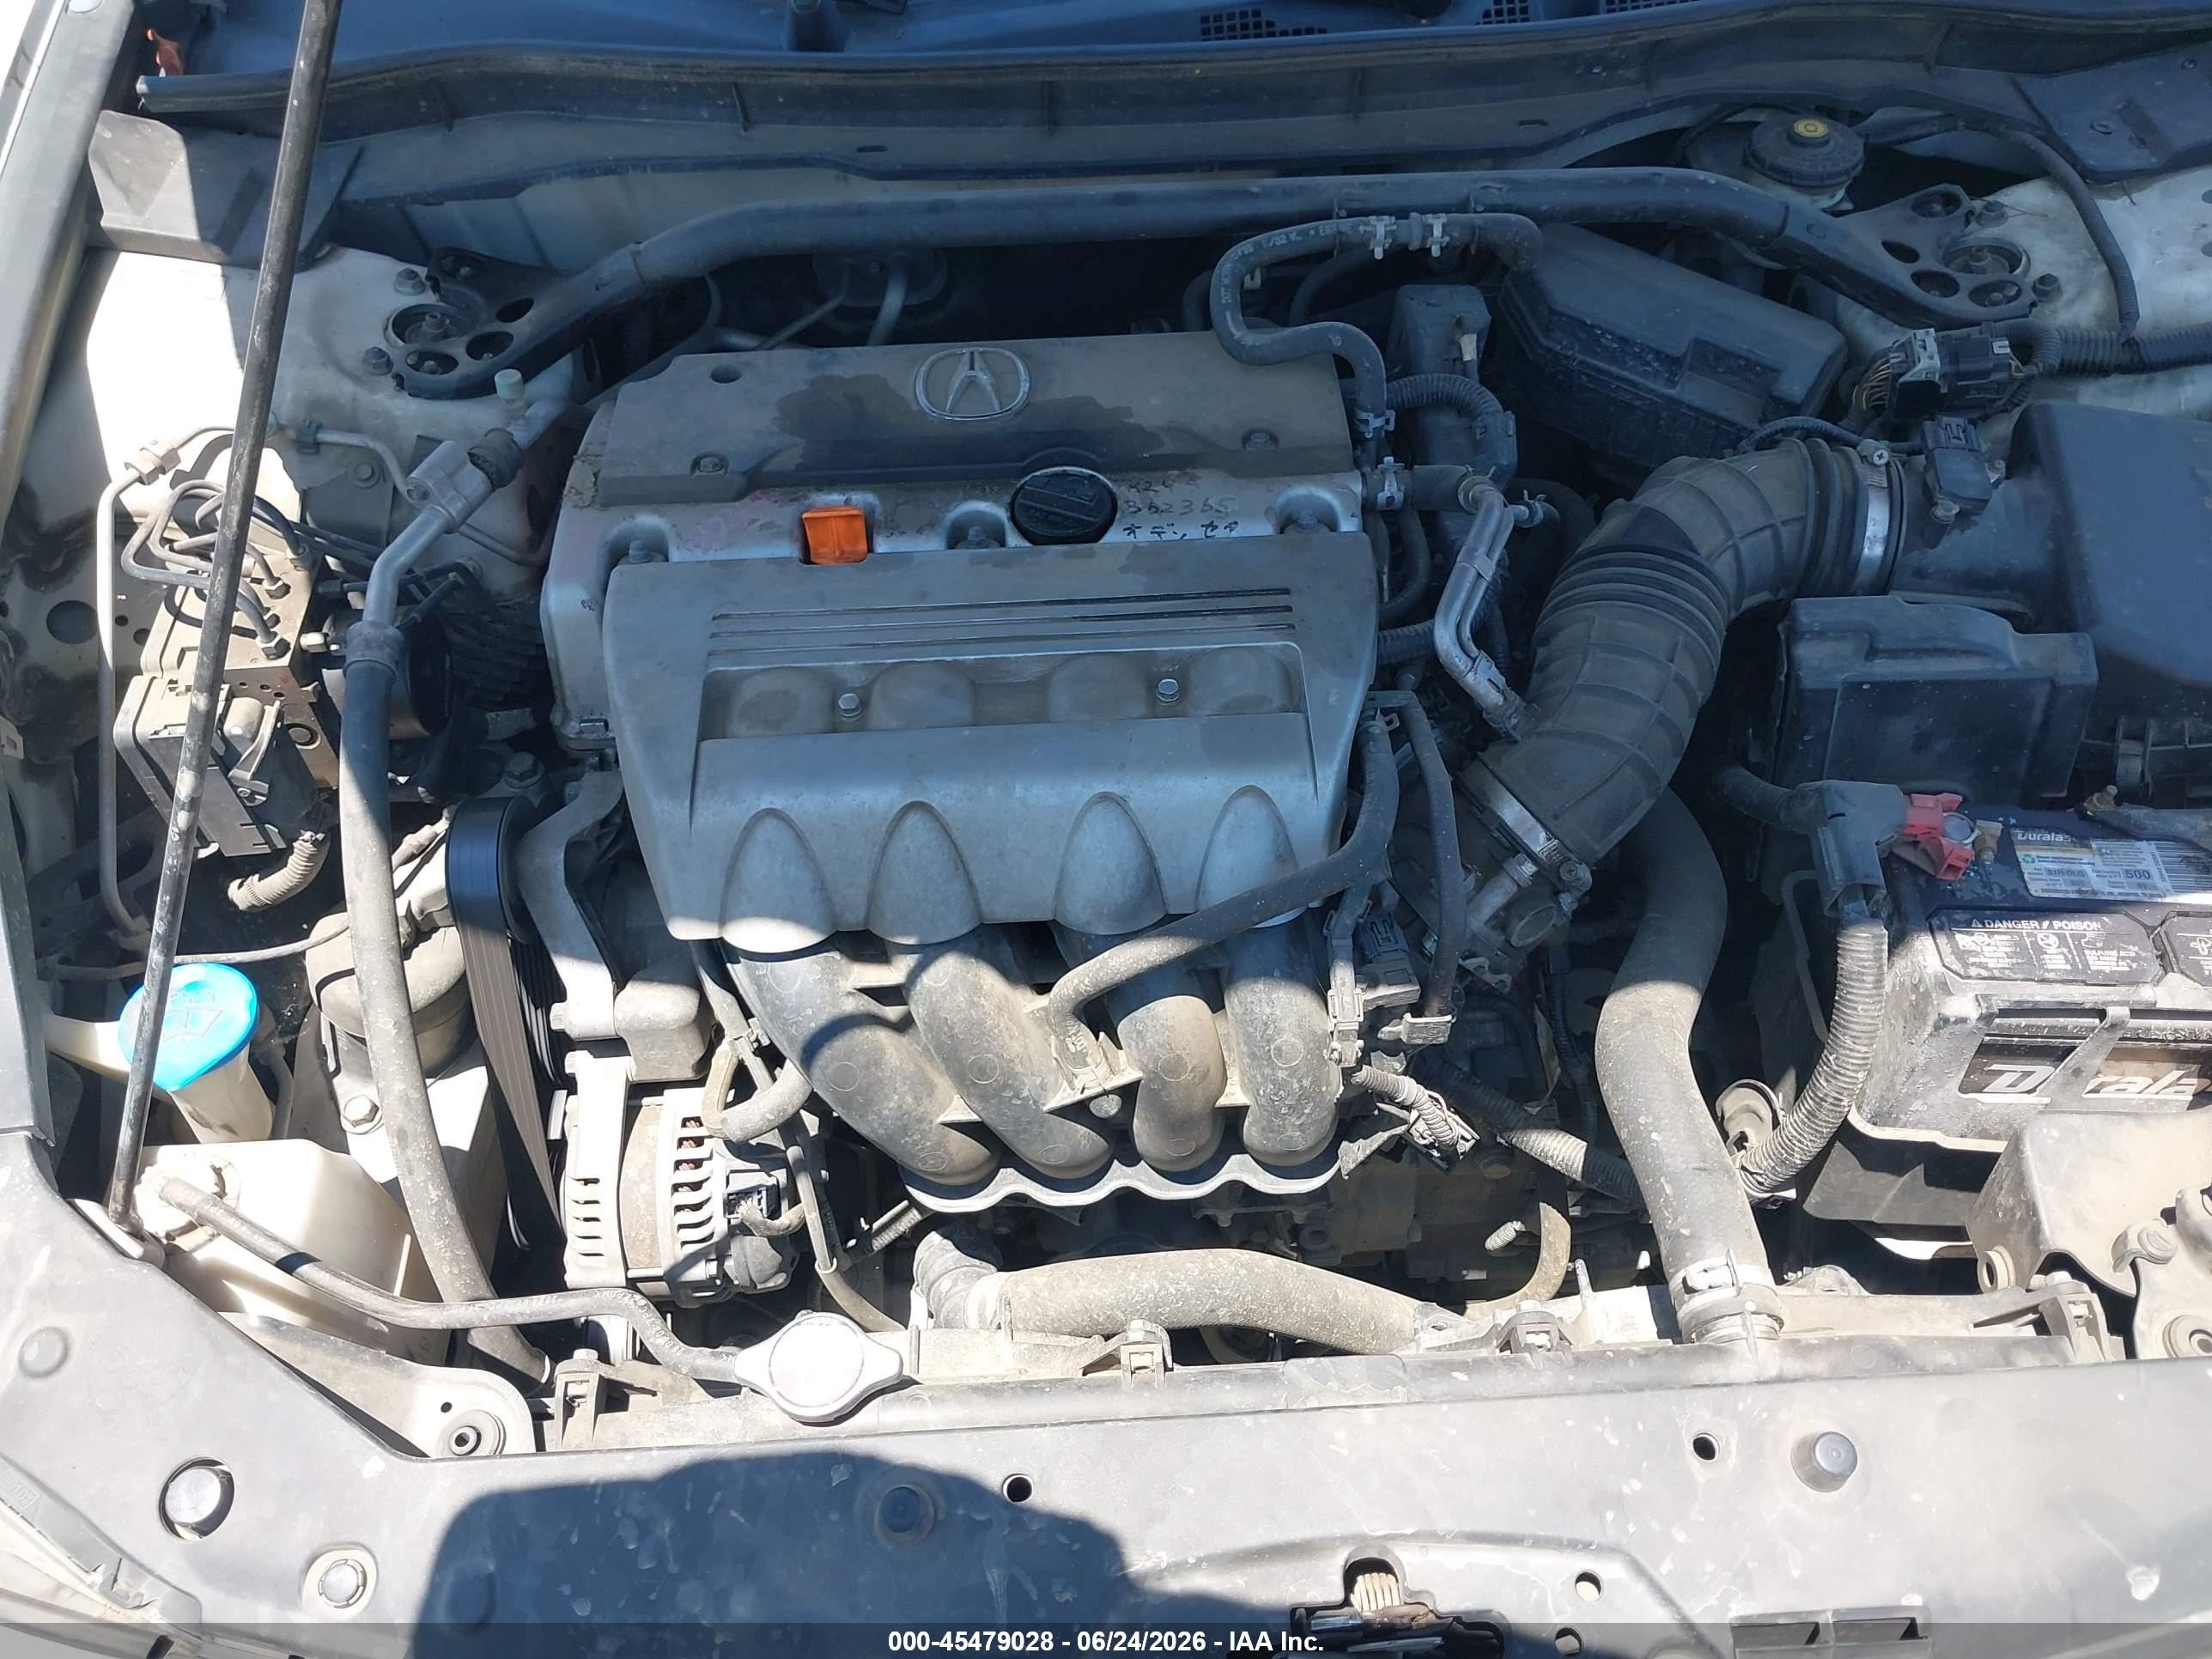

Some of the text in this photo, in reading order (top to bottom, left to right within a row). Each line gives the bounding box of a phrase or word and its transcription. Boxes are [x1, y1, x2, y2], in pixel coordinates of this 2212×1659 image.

[2126, 870, 2151, 880] 500
[1984, 920, 2040, 930] DANGER
[2052, 921, 2102, 931] POISON
